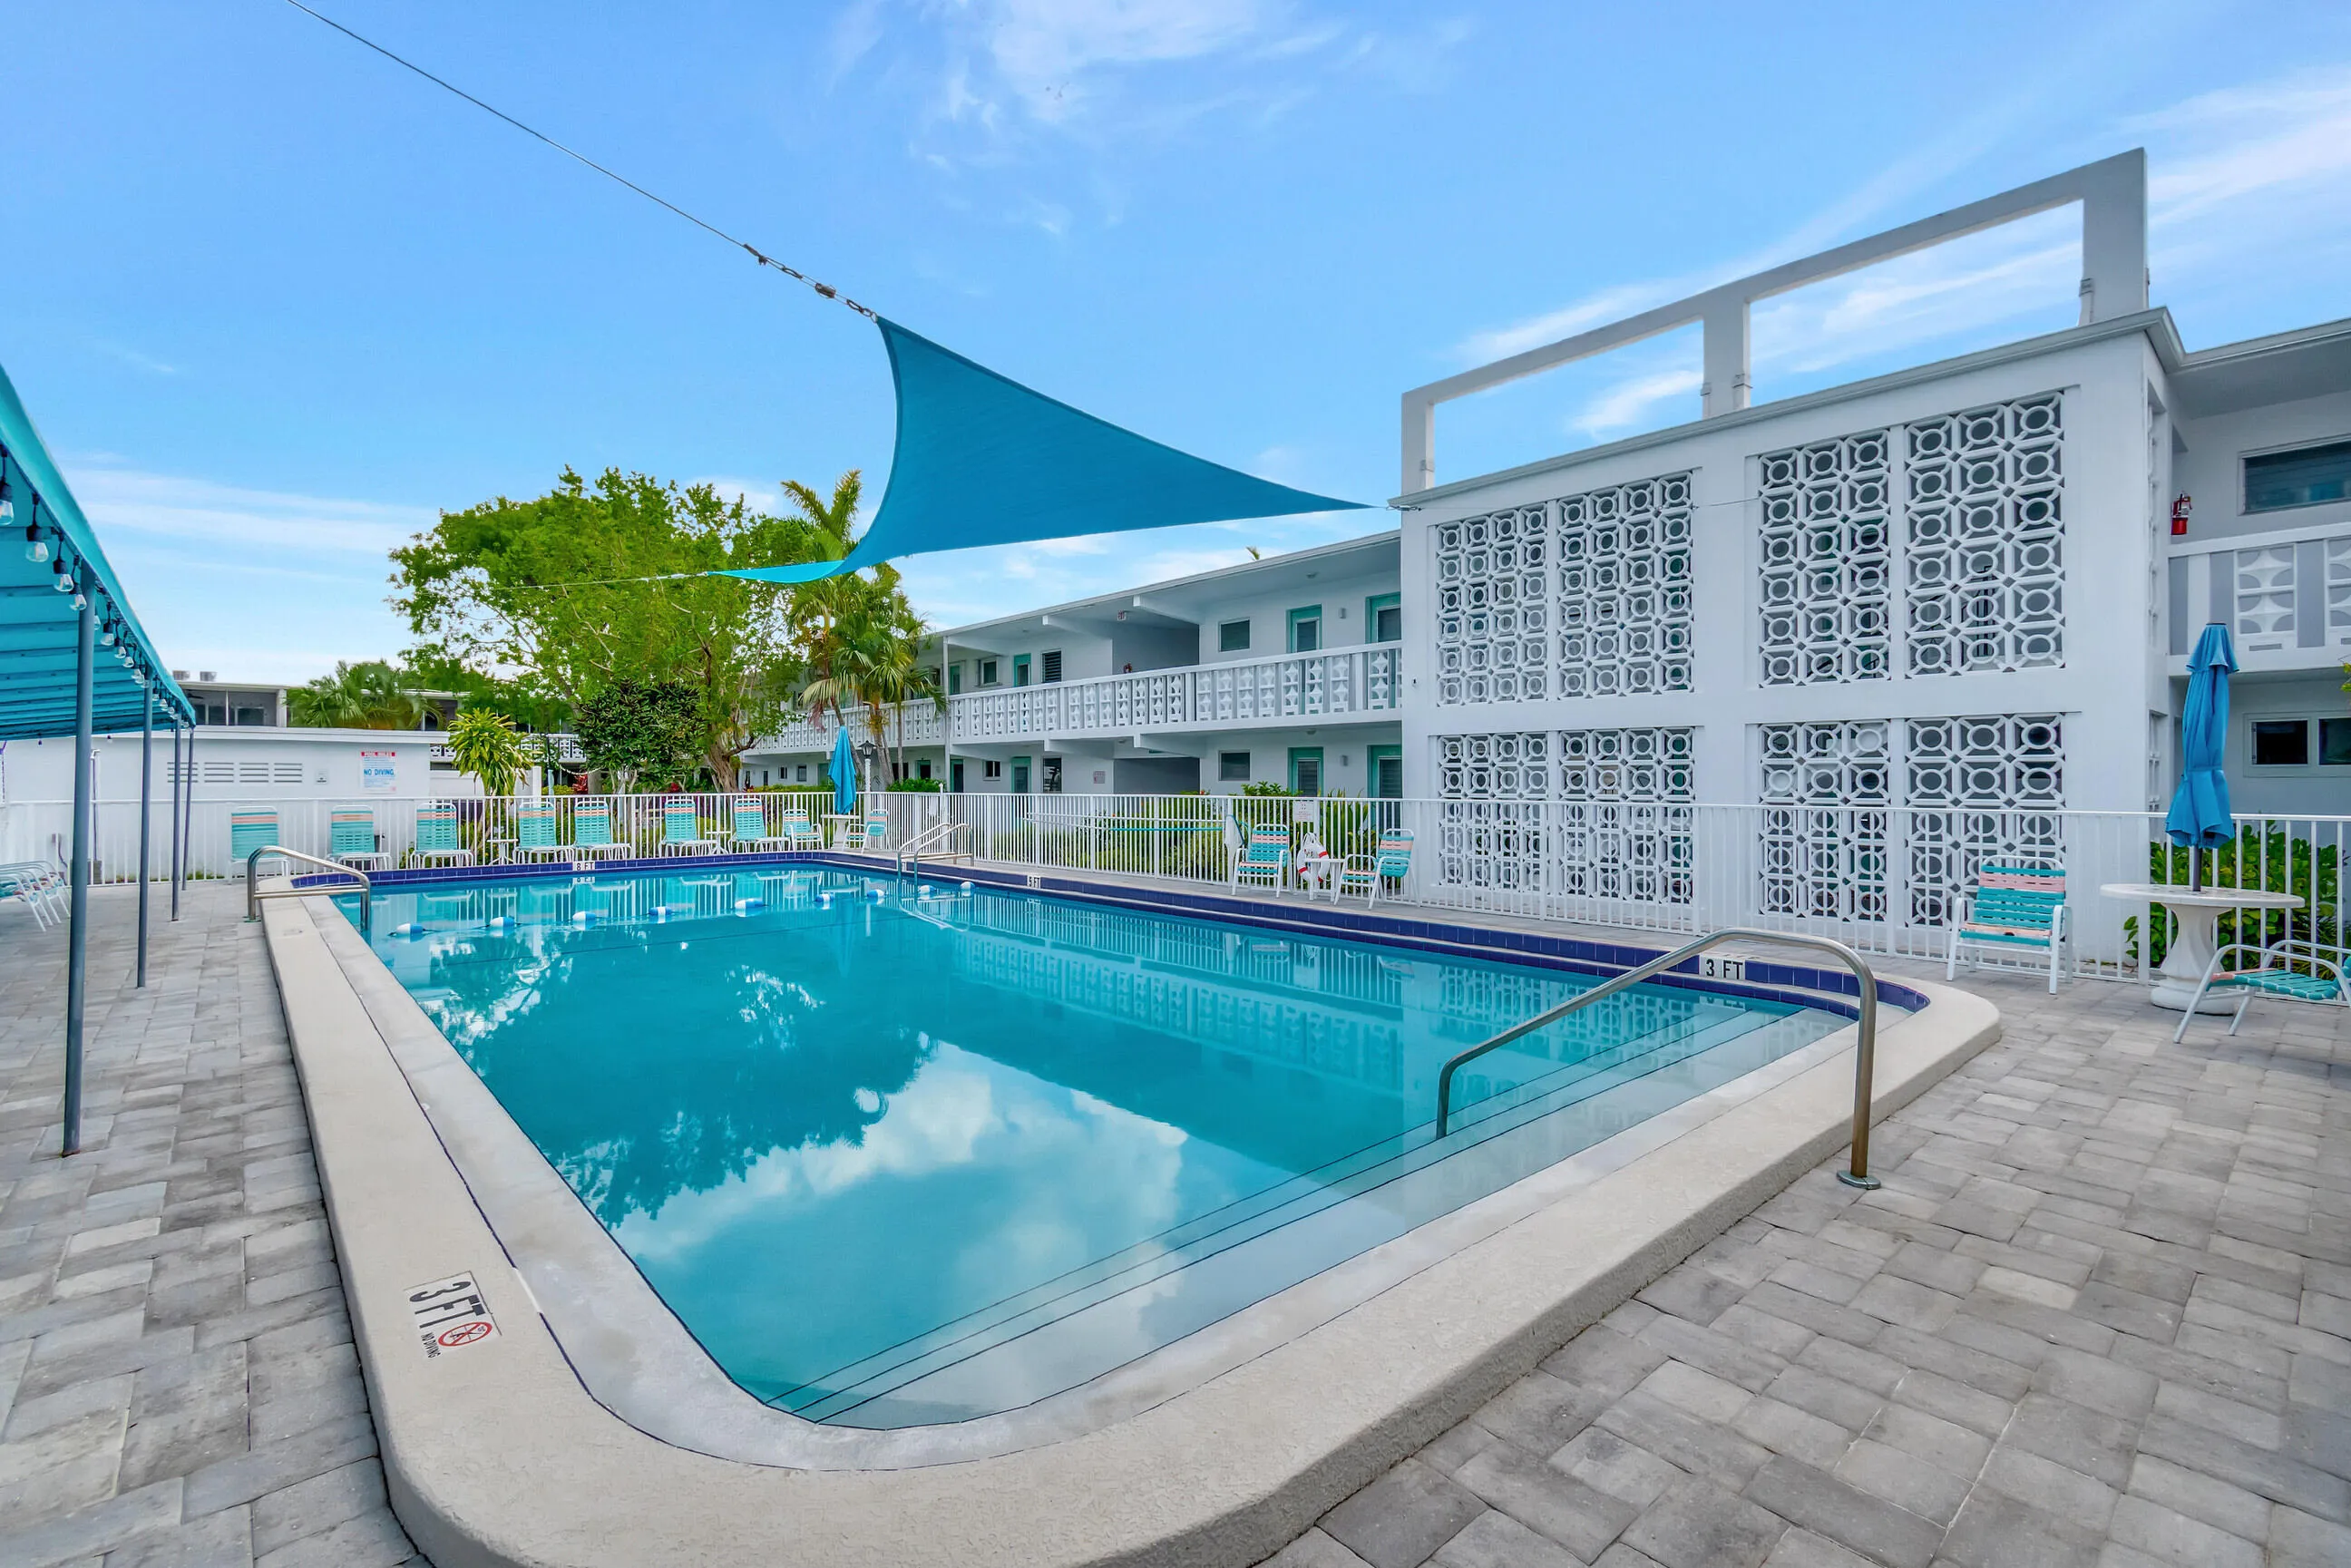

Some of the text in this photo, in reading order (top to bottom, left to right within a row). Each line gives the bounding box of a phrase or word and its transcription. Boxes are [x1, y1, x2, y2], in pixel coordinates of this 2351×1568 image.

[576, 862, 593, 871] 8 FT
[1706, 959, 1742, 979] 3 FT
[423, 1339, 442, 1359] DIVING
